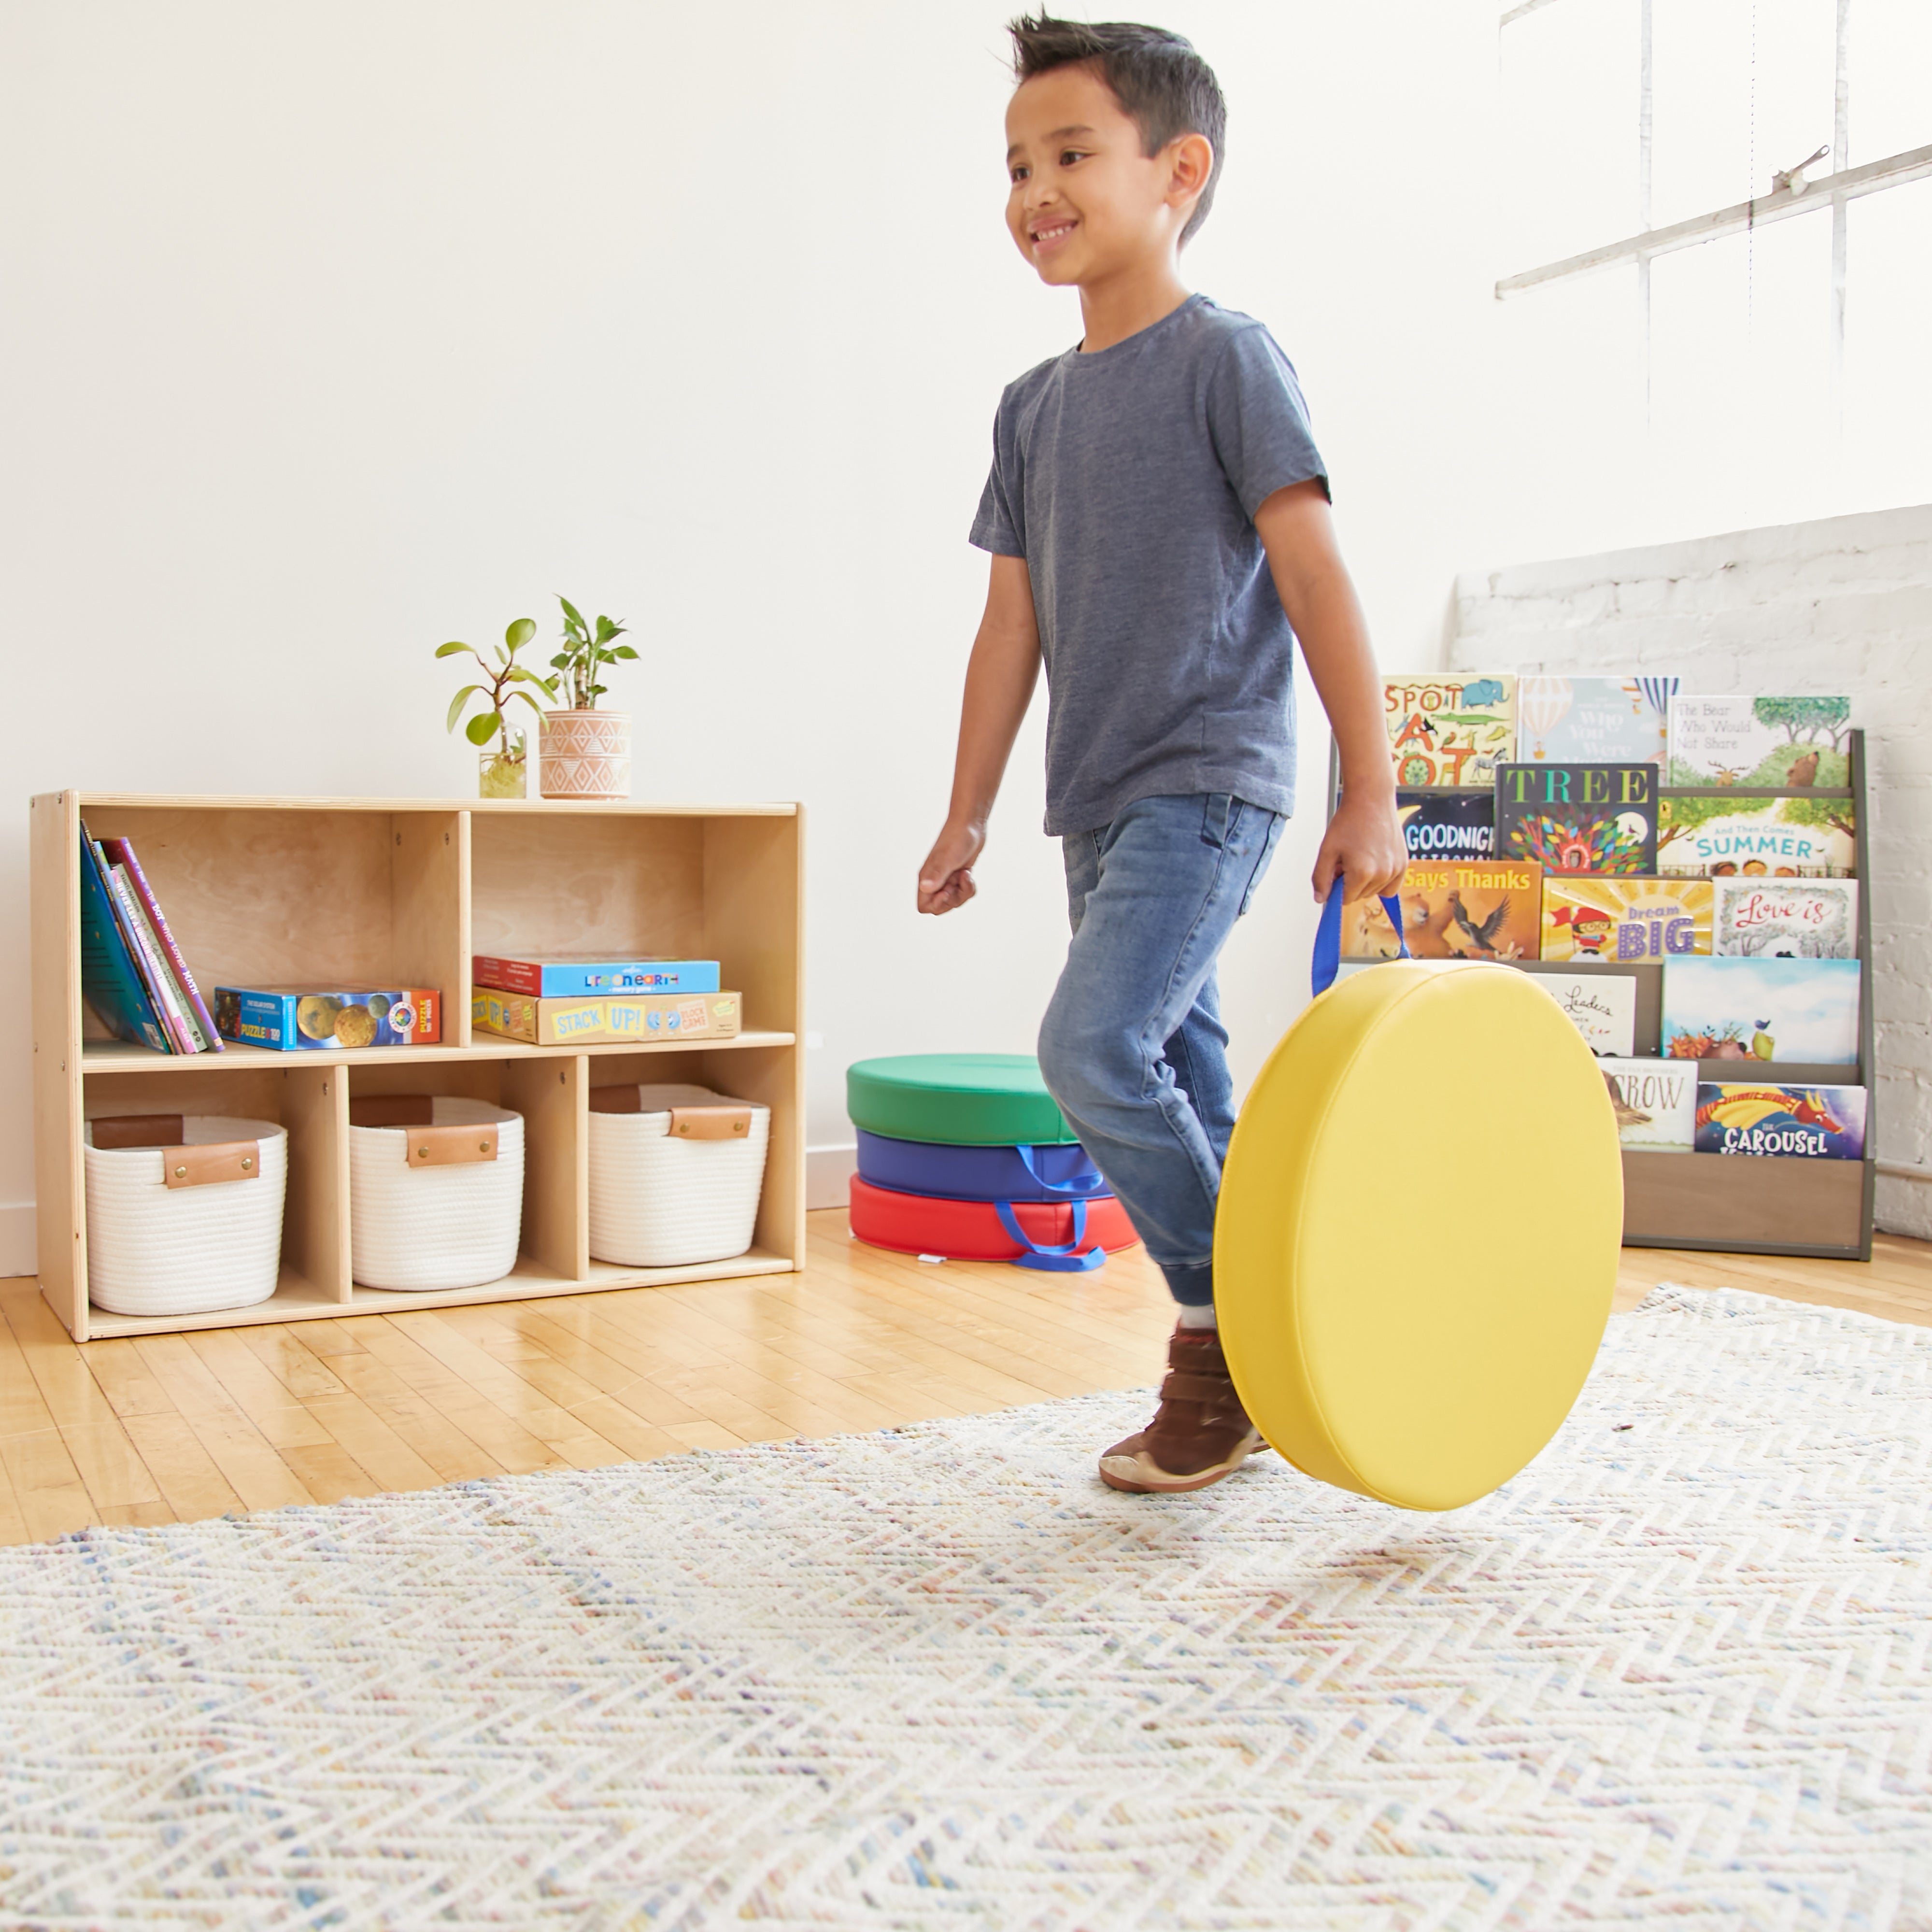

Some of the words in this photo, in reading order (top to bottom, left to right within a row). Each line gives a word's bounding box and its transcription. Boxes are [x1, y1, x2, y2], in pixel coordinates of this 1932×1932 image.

[1385, 684, 1463, 713] SPOT
[1676, 703, 1697, 716] The
[1703, 703, 1731, 716] Bear
[1394, 713, 1433, 752] A
[1569, 725, 1604, 739] You
[1679, 720, 1706, 732] Who
[1712, 720, 1750, 732] Would
[1583, 742, 1631, 757] Were
[1677, 737, 1697, 749] Not
[1705, 737, 1738, 749] Share
[1397, 748, 1477, 786] OT
[1506, 769, 1648, 803] TREE
[1715, 826, 1733, 835] And
[1763, 825, 1794, 835] Comes
[1697, 836, 1812, 859] SUMMER
[1403, 868, 1449, 892] Says
[1455, 869, 1530, 890] Thanks
[115, 882, 132, 906] NEVER
[126, 906, 137, 920] LET
[135, 927, 153, 953] UNICORN
[1629, 906, 1679, 920] Dream
[1736, 895, 1801, 927] Love
[1804, 900, 1832, 923] is
[152, 903, 165, 920] BOY
[162, 922, 174, 942] WHO
[170, 944, 186, 968] LOVED
[182, 970, 199, 995] MATH
[1618, 916, 1695, 960] BIG
[1563, 985, 1613, 1017] Leaders
[241, 1023, 265, 1039] PUZZLE
[557, 1009, 601, 1035] STACK
[611, 1007, 641, 1031] UP!
[682, 1016, 706, 1030] GAME
[1724, 1128, 1828, 1155] CAROUSEL
